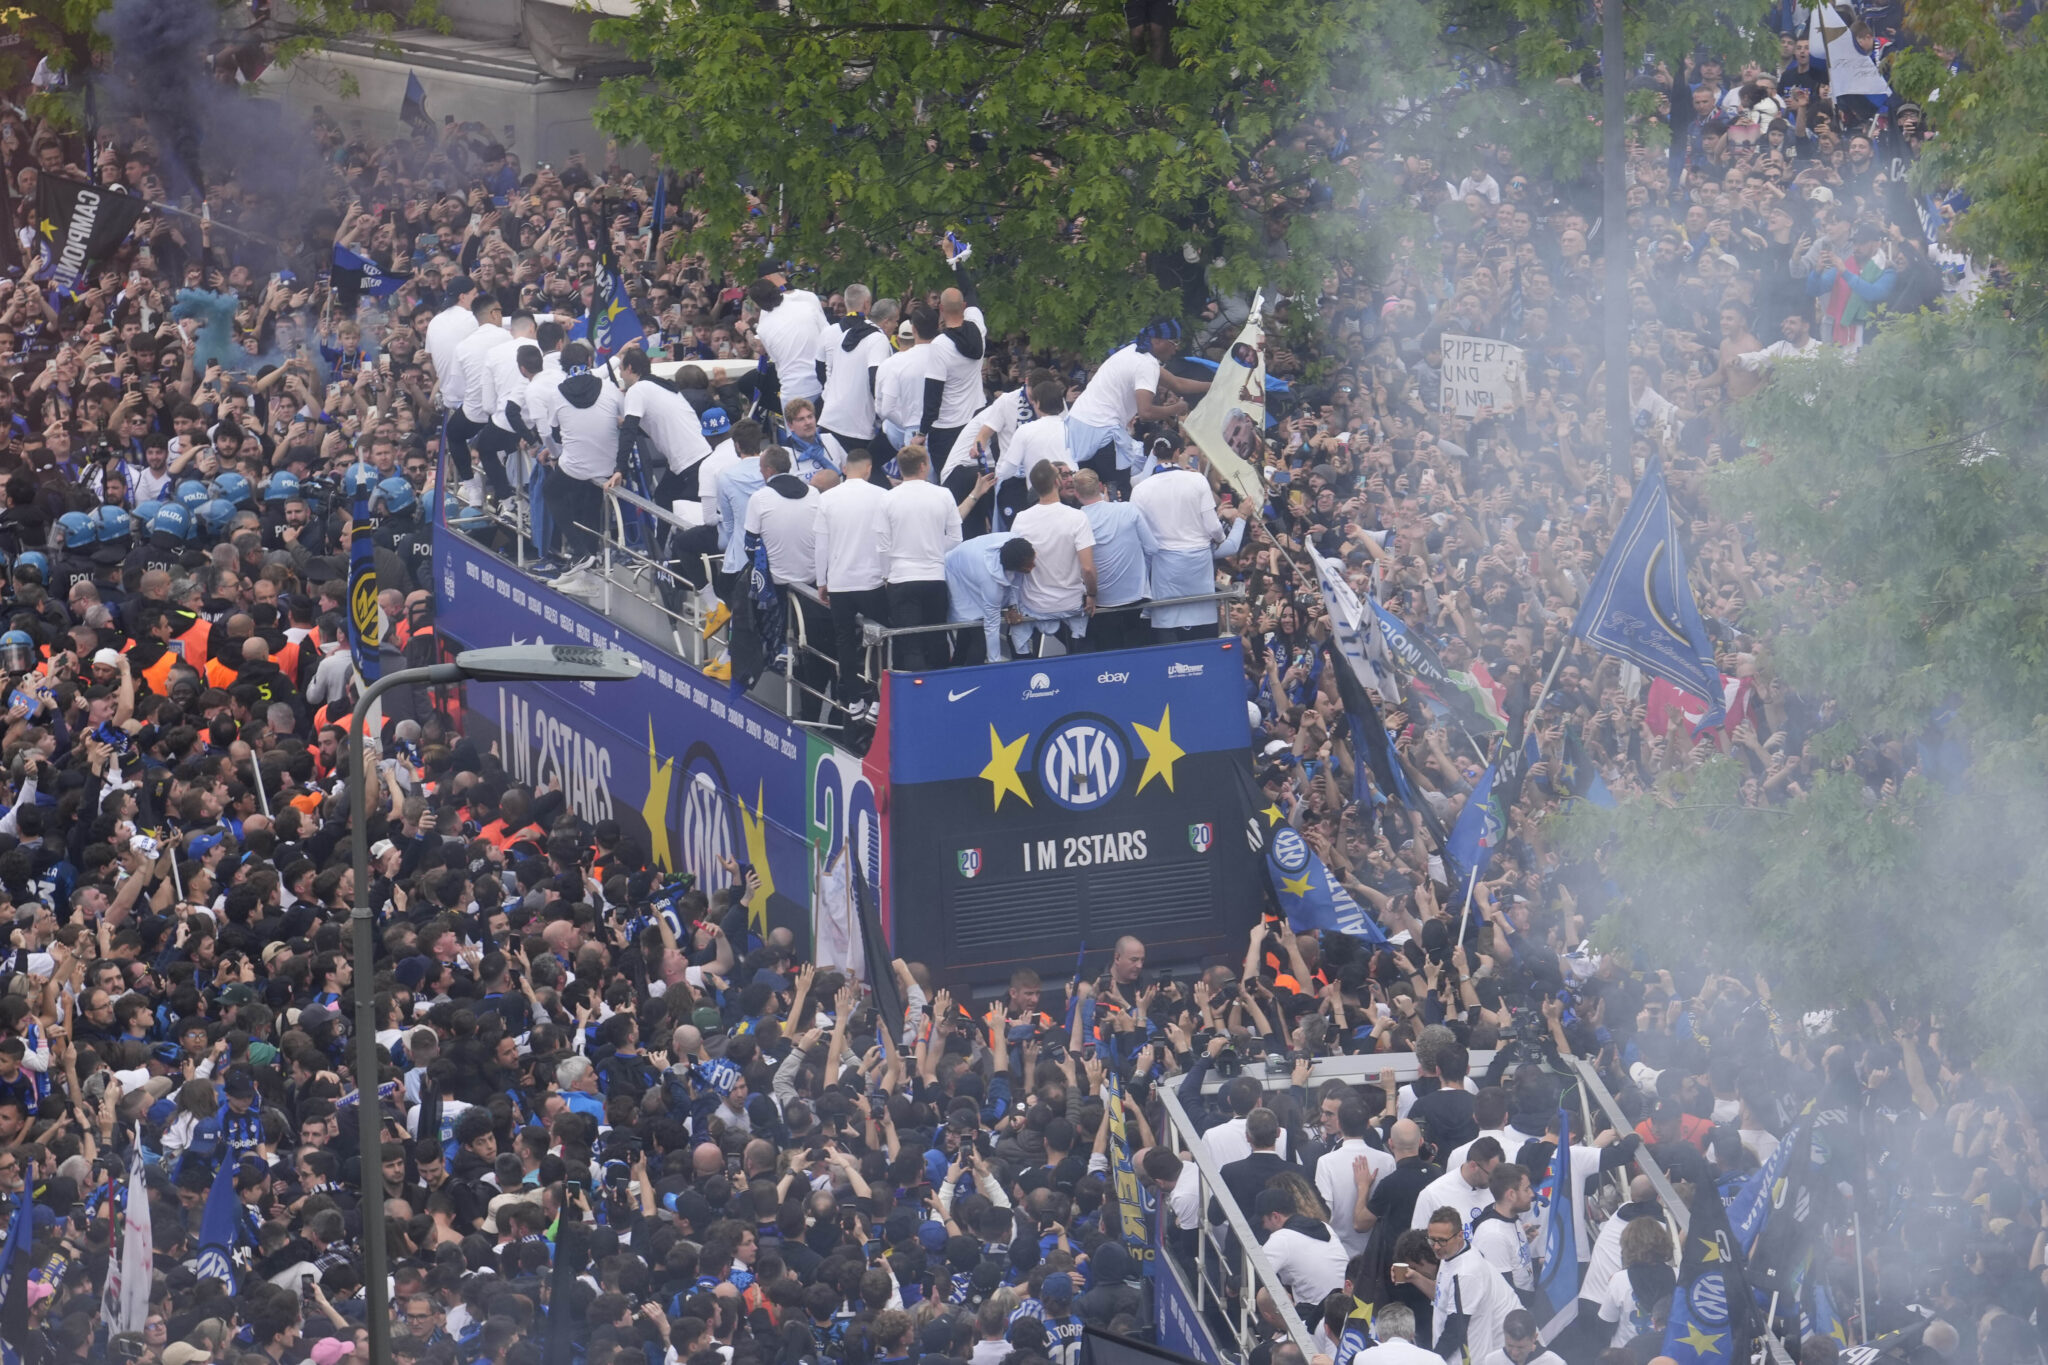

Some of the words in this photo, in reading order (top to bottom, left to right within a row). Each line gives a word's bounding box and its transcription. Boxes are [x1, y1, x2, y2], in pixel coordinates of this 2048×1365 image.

[1443, 340, 1509, 362] RIPERT
[1443, 365, 1479, 383] UNO
[184, 492, 208, 503] POLIZIA
[158, 510, 183, 524] POLIZIA
[1097, 671, 1130, 685] ebay
[535, 709, 613, 826] 2STARS
[1191, 826, 1210, 845] 20
[1023, 842, 1032, 872] I
[1037, 840, 1057, 871] M
[1063, 830, 1148, 868] 2STARS
[961, 852, 979, 871] 20
[1053, 1323, 1084, 1340] TORR
